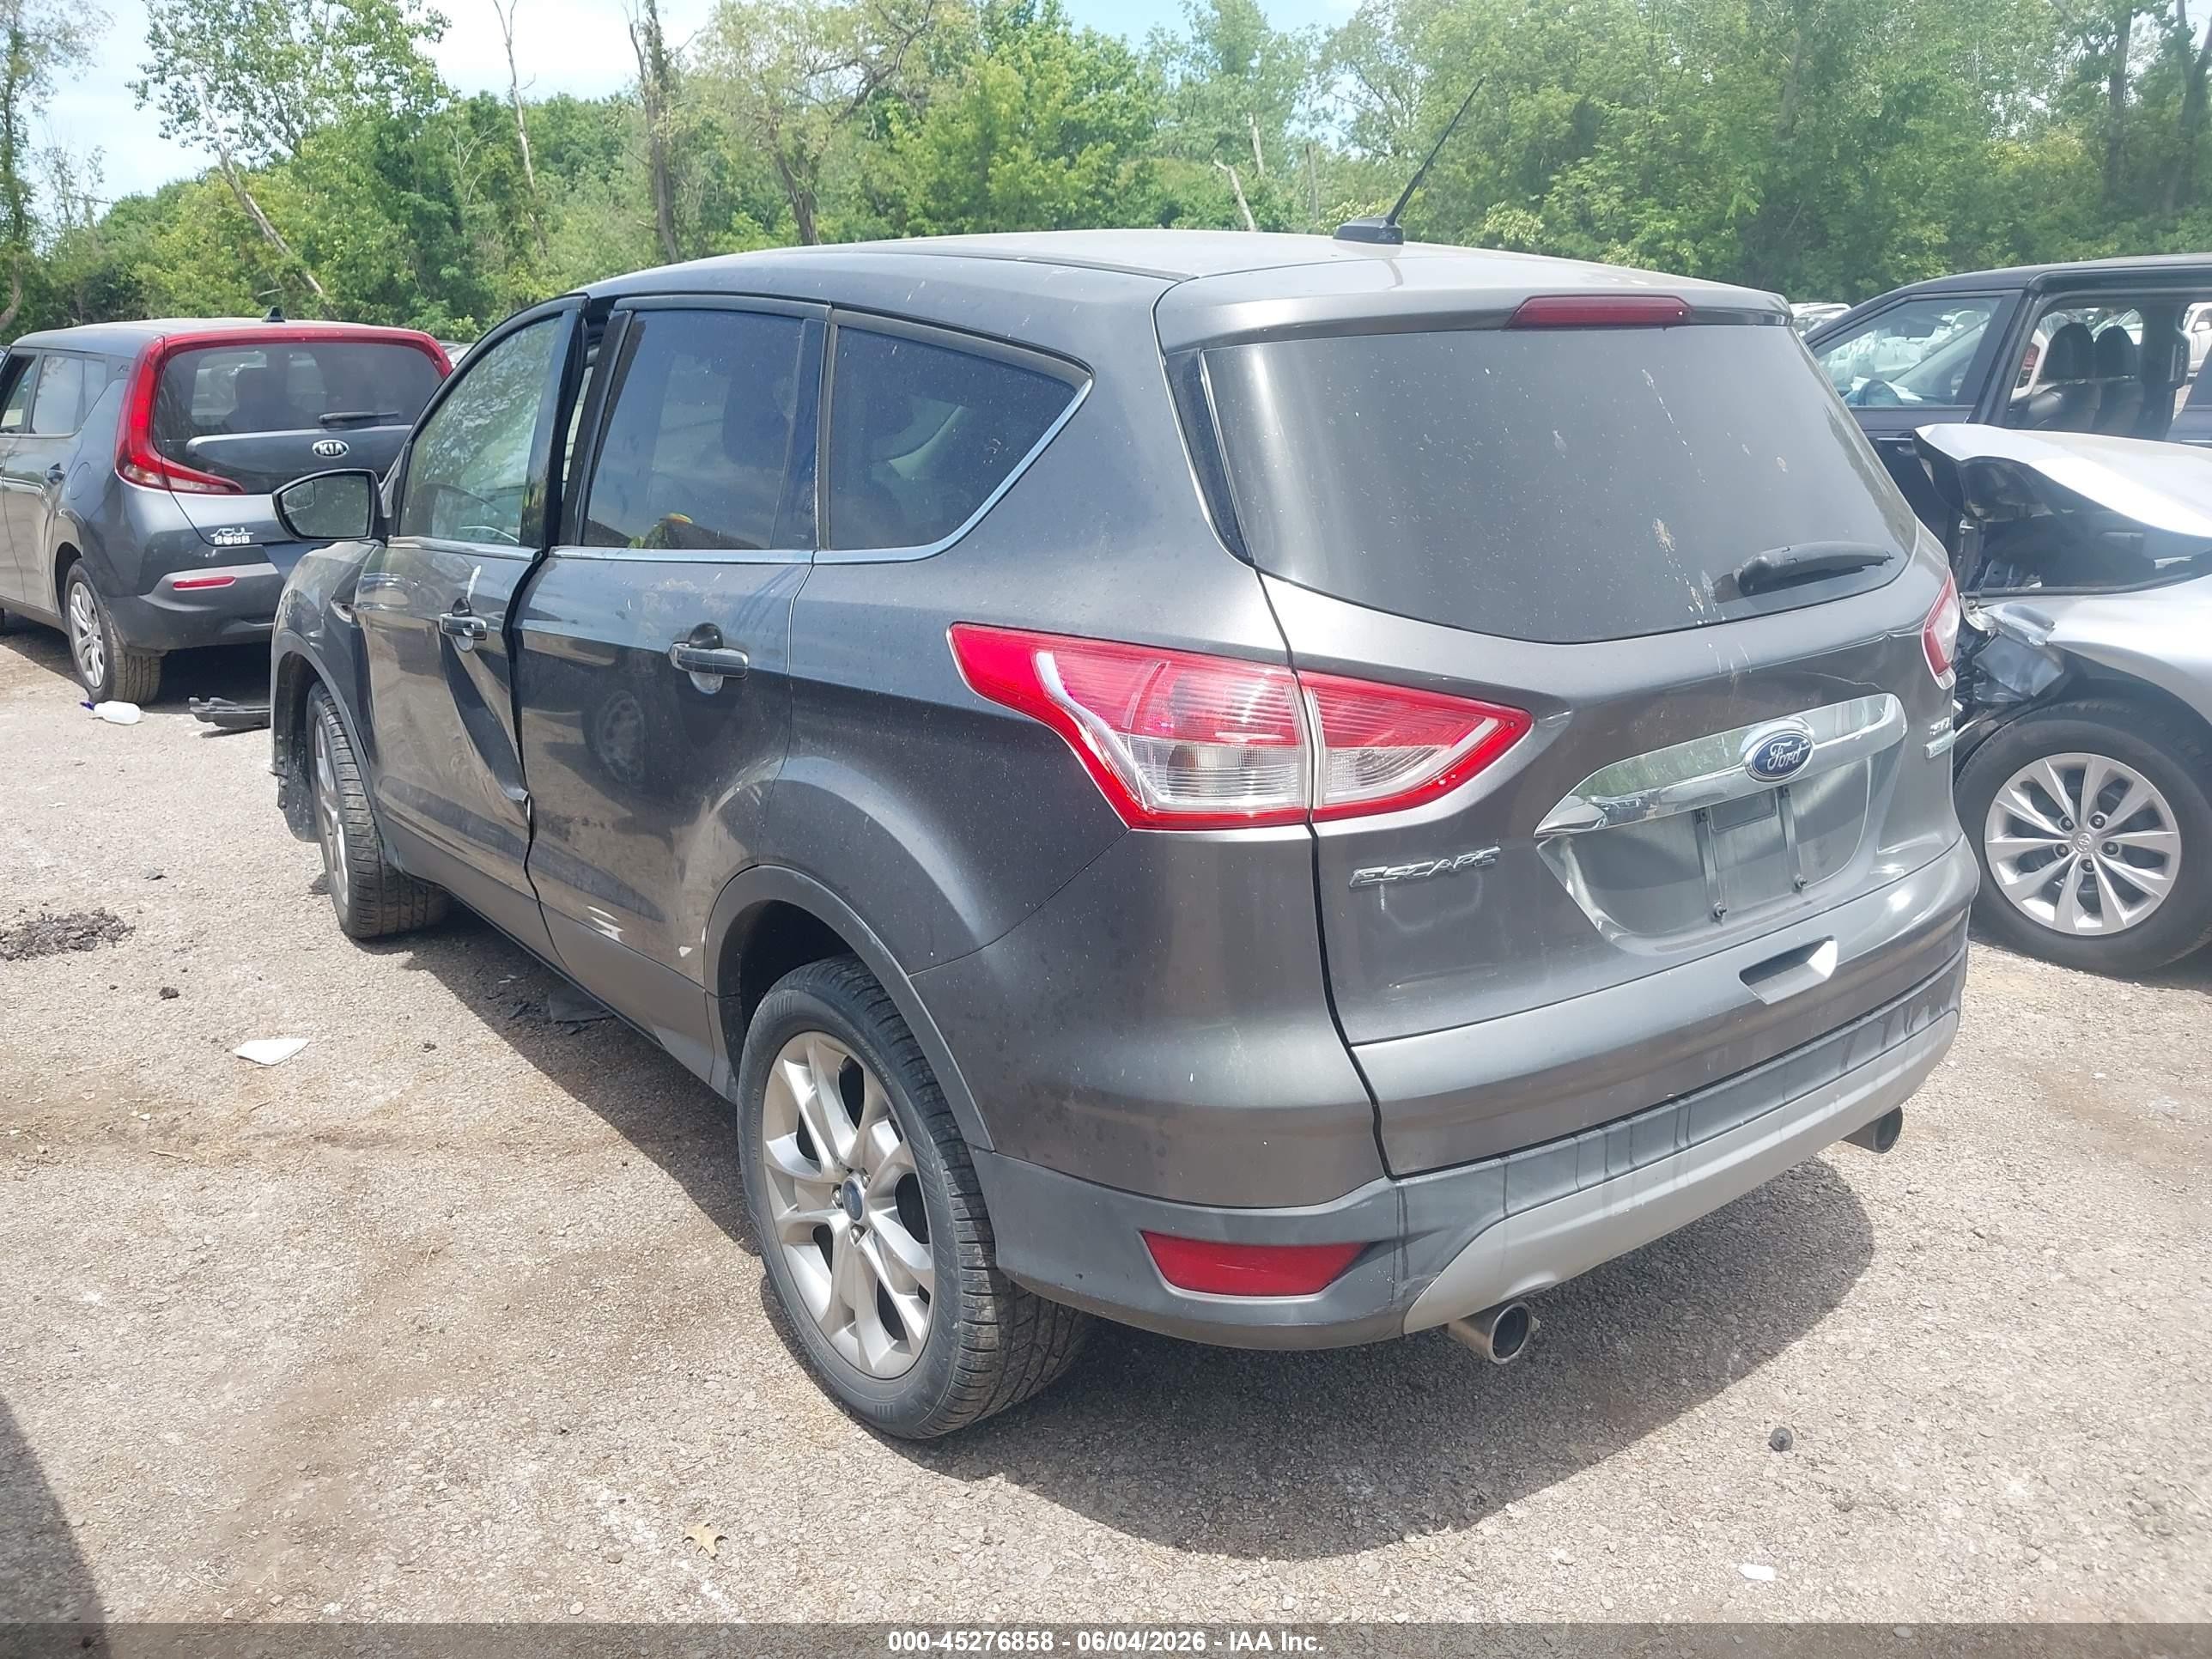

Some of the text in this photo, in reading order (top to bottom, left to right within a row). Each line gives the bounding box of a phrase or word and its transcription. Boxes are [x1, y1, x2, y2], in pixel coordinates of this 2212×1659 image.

[210, 526, 254, 538] SOUL
[1766, 738, 1811, 771] Ford
[1348, 846, 1502, 888] ESCAPE
